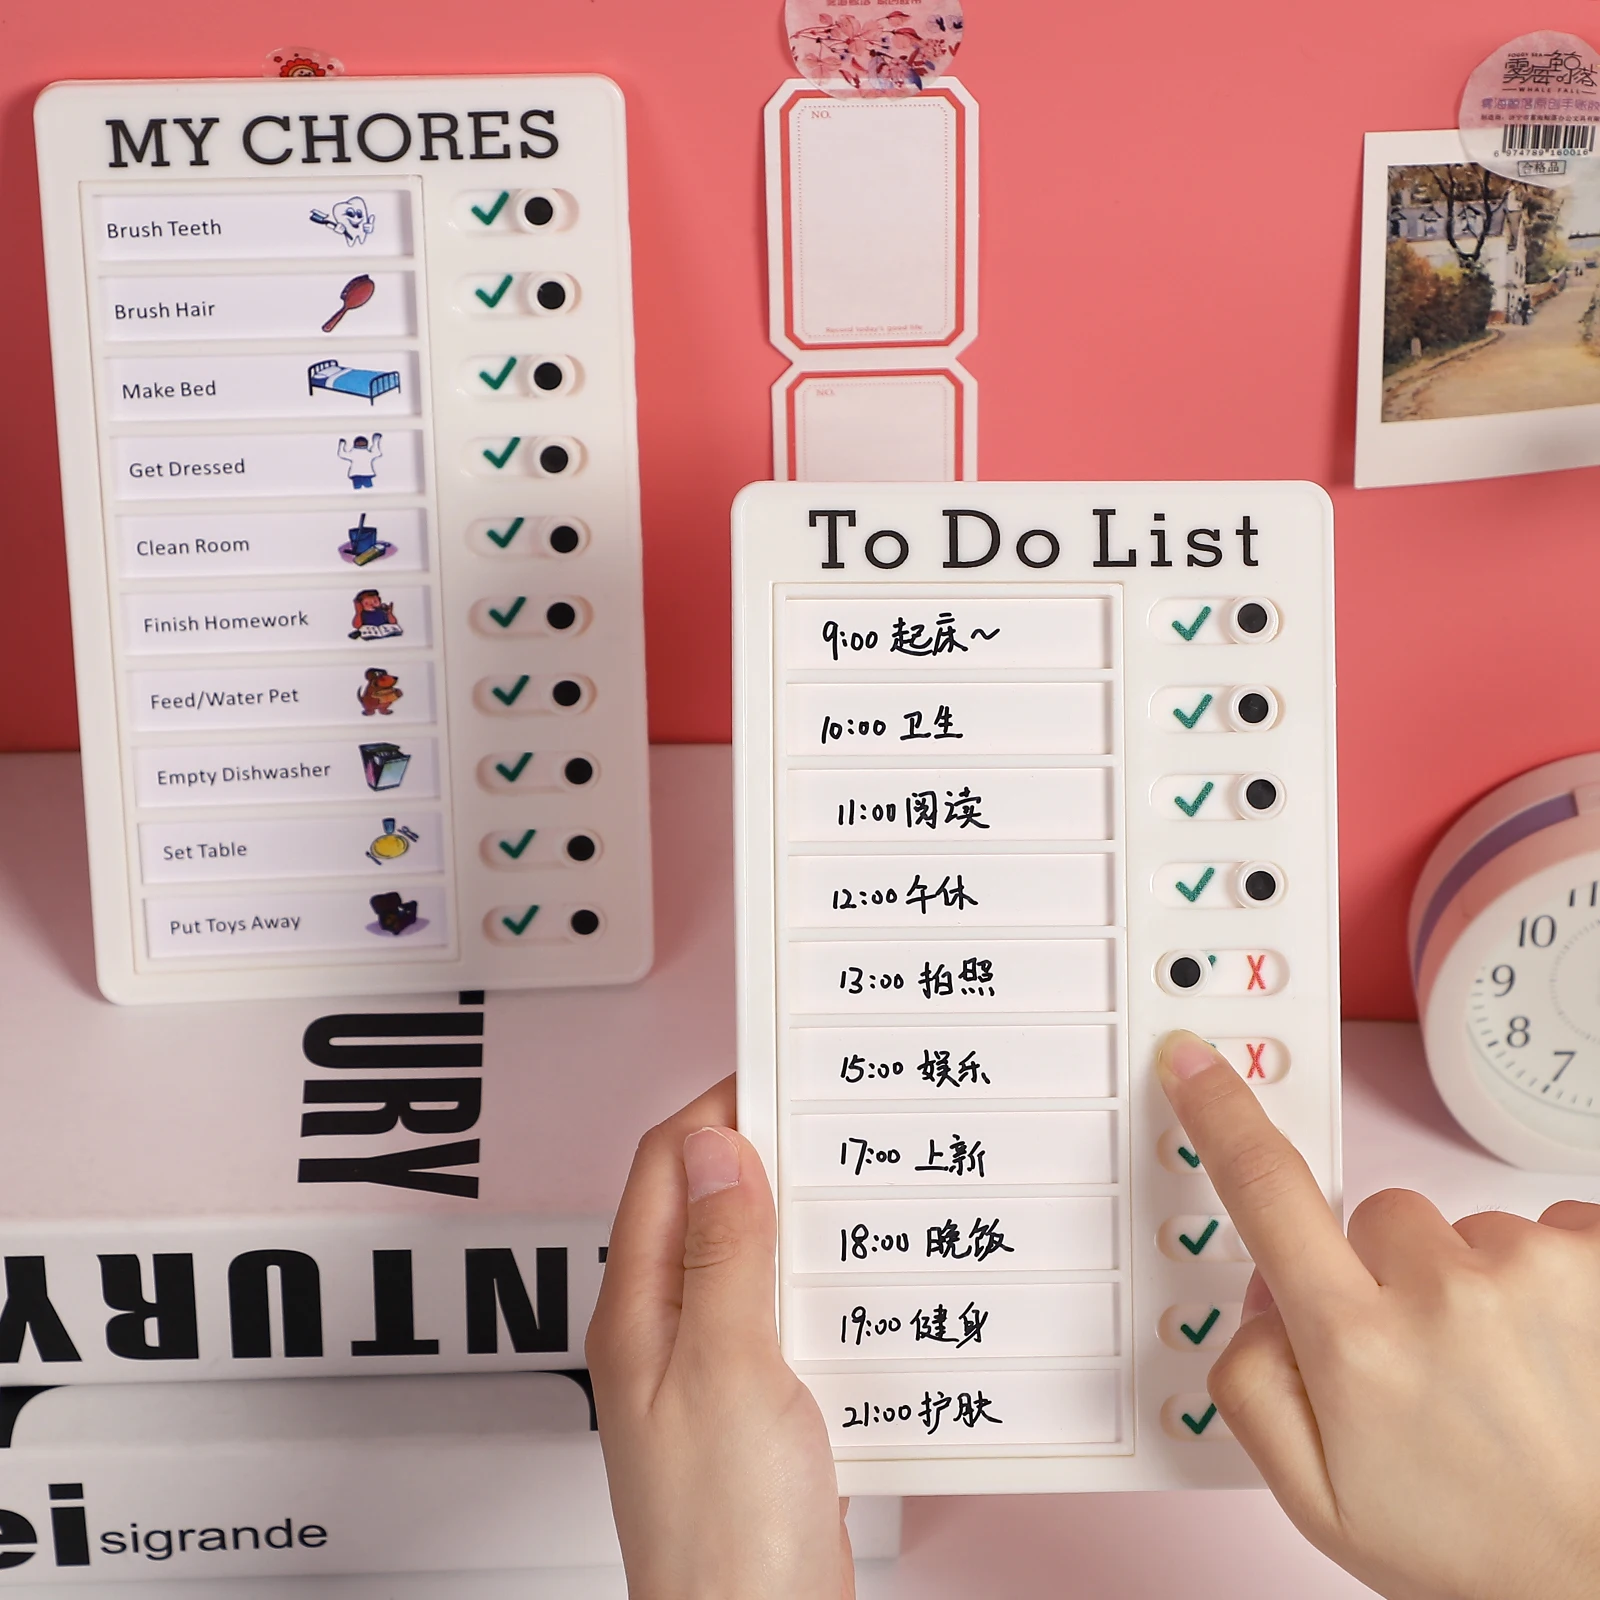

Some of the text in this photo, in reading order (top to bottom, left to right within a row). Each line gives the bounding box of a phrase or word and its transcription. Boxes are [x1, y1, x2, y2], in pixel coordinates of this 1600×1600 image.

[811, 110, 831, 119] NO.
[106, 109, 559, 168] MY CHORES
[1522, 161, 1559, 174] 合格品
[108, 219, 221, 238] Brush Teeth
[115, 302, 214, 319] Brush Hair
[887, 324, 907, 332] good
[123, 380, 216, 399] Make Bed
[816, 389, 835, 397] NO.
[130, 459, 244, 477] Get Dressed
[137, 539, 249, 556] Clean Room
[809, 509, 1258, 569] To Do List
[145, 611, 308, 632] Finish Homework
[823, 621, 878, 660] 9:00
[151, 689, 298, 709] Feed/Water Pet
[822, 705, 963, 744] 10:00 卫生
[158, 763, 330, 787] Empty Dishwasher
[839, 787, 990, 829] 11:00 阅读
[164, 842, 246, 860] Set Table
[833, 875, 978, 914] 12:00 午休
[171, 916, 300, 934] Put Toys Away
[1518, 914, 1557, 948] 10
[840, 957, 995, 999] 13:00 拍照
[1491, 964, 1516, 997] 9
[1505, 1016, 1531, 1048] 8
[841, 1050, 990, 1087] 15:00 娱乐
[1552, 1052, 1577, 1082] 7
[297, 990, 485, 1199] URY
[841, 1134, 985, 1177] 17:00 上新
[841, 1218, 1014, 1262] 18:00 晚饭
[0, 1247, 608, 1363] NTURY
[841, 1302, 988, 1348] 19:00 健身
[842, 1391, 1002, 1435] 21:00 护肤
[100, 1518, 328, 1560] sigrande
